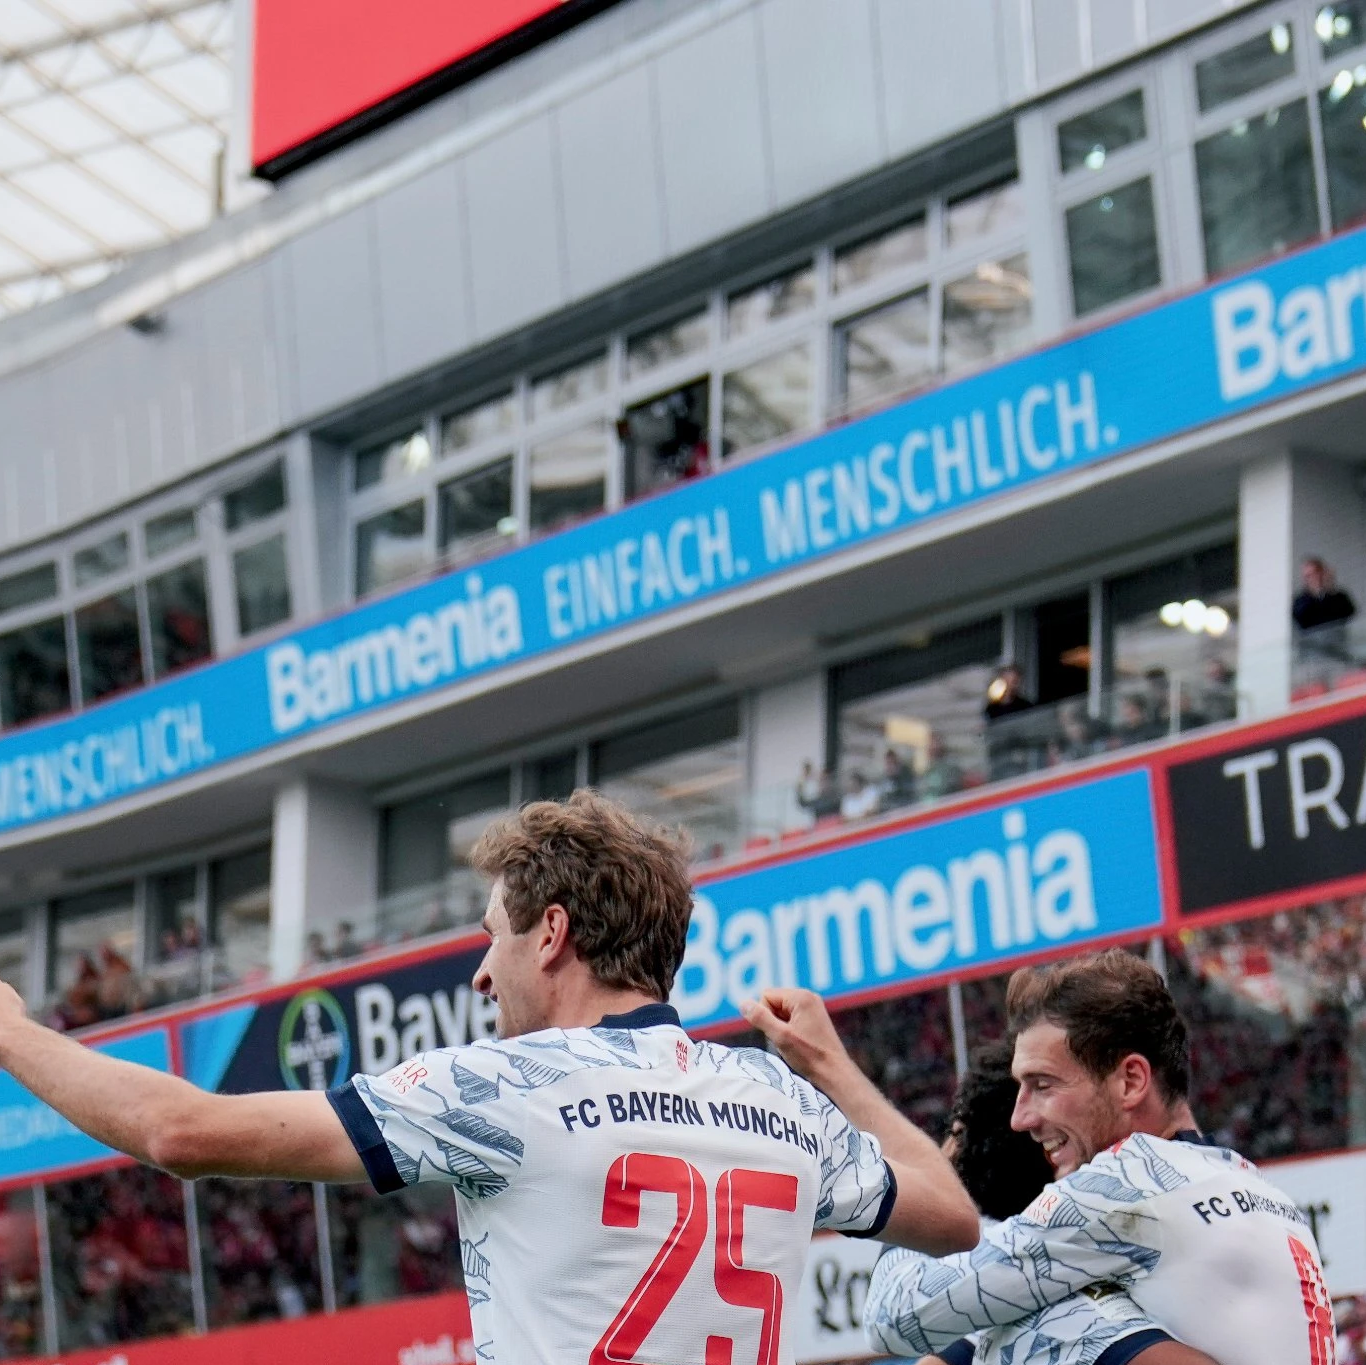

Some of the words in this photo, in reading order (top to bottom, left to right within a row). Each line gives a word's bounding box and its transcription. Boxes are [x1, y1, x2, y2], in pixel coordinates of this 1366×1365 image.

[266, 573, 522, 733] Barmenia
[543, 508, 750, 640] EINFACH.
[761, 373, 1119, 563] MENSCHLICH.
[680, 812, 1098, 1010] Barmenia
[558, 1098, 601, 1134] FC
[606, 1091, 705, 1128] BAYERN
[707, 1101, 820, 1160] MÜNCHEN
[1192, 1197, 1232, 1226] FC
